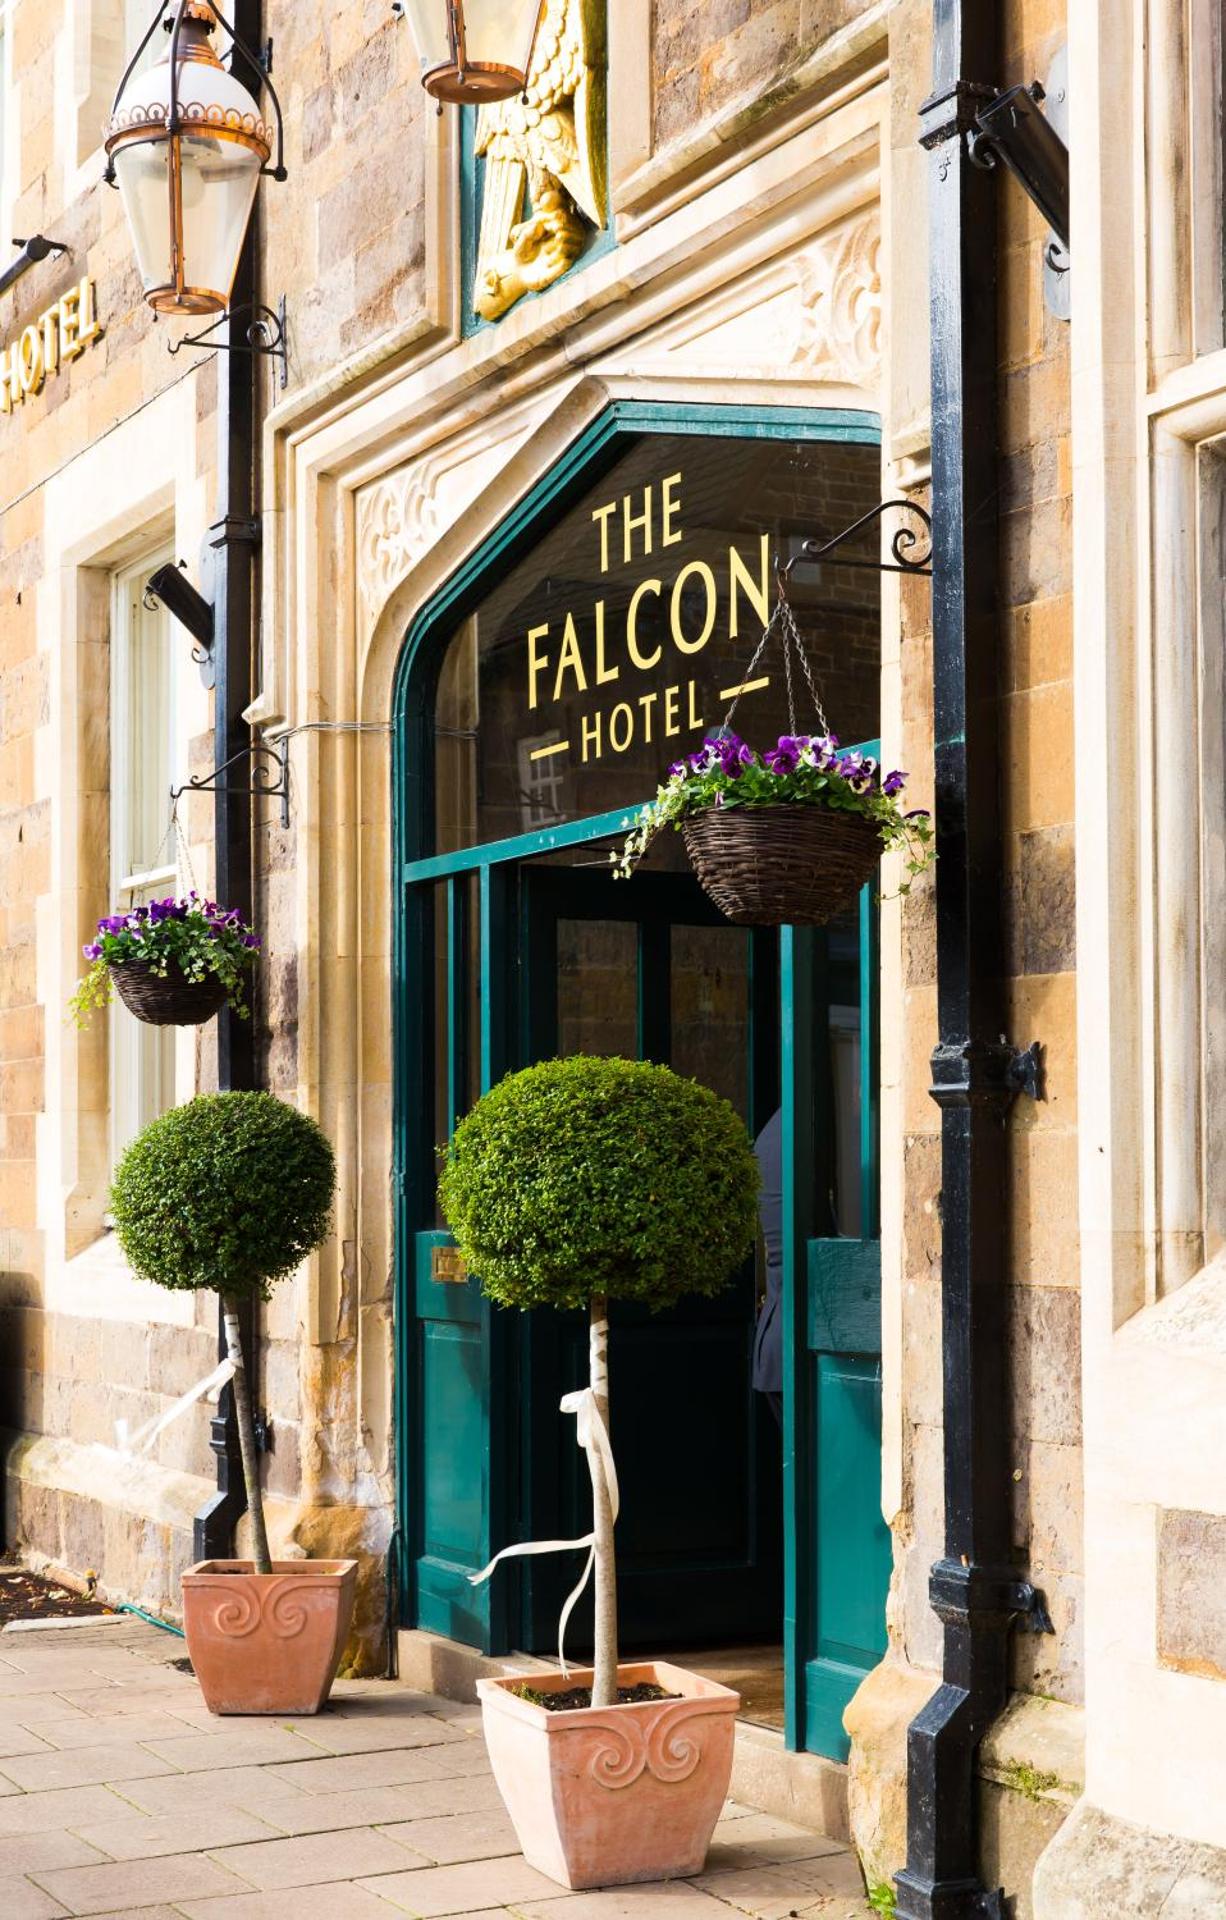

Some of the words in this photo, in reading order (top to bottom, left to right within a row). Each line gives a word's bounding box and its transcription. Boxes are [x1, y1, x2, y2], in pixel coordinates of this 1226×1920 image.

[0, 276, 101, 413] HOTEL
[592, 471, 682, 573] THE
[527, 533, 769, 710] FALCON
[581, 680, 704, 763] HOTEL
